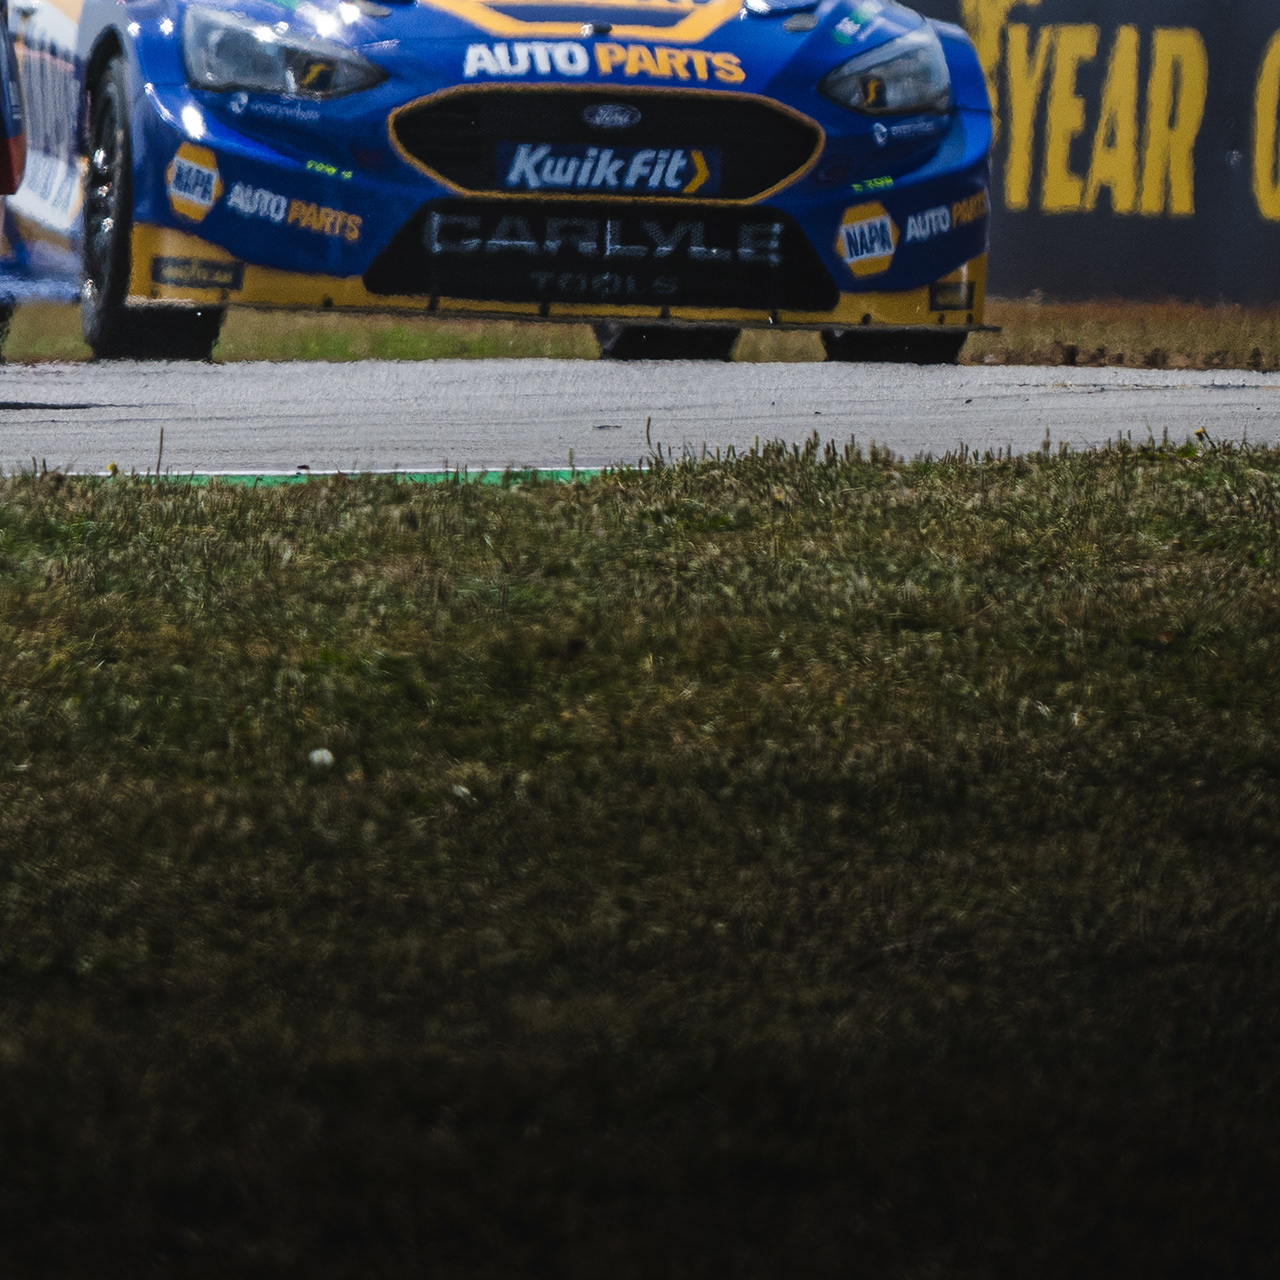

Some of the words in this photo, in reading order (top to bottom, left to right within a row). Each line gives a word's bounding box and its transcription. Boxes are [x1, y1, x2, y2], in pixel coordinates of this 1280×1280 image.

[464, 41, 590, 78] AUTO
[594, 43, 747, 85] PARTS
[1002, 23, 1210, 217] YEAR
[227, 181, 288, 222] AUTO
[288, 198, 363, 242] PARTS
[906, 205, 950, 242] AUTO
[422, 210, 784, 267] CARLYLE
[844, 221, 894, 260] NAPA
